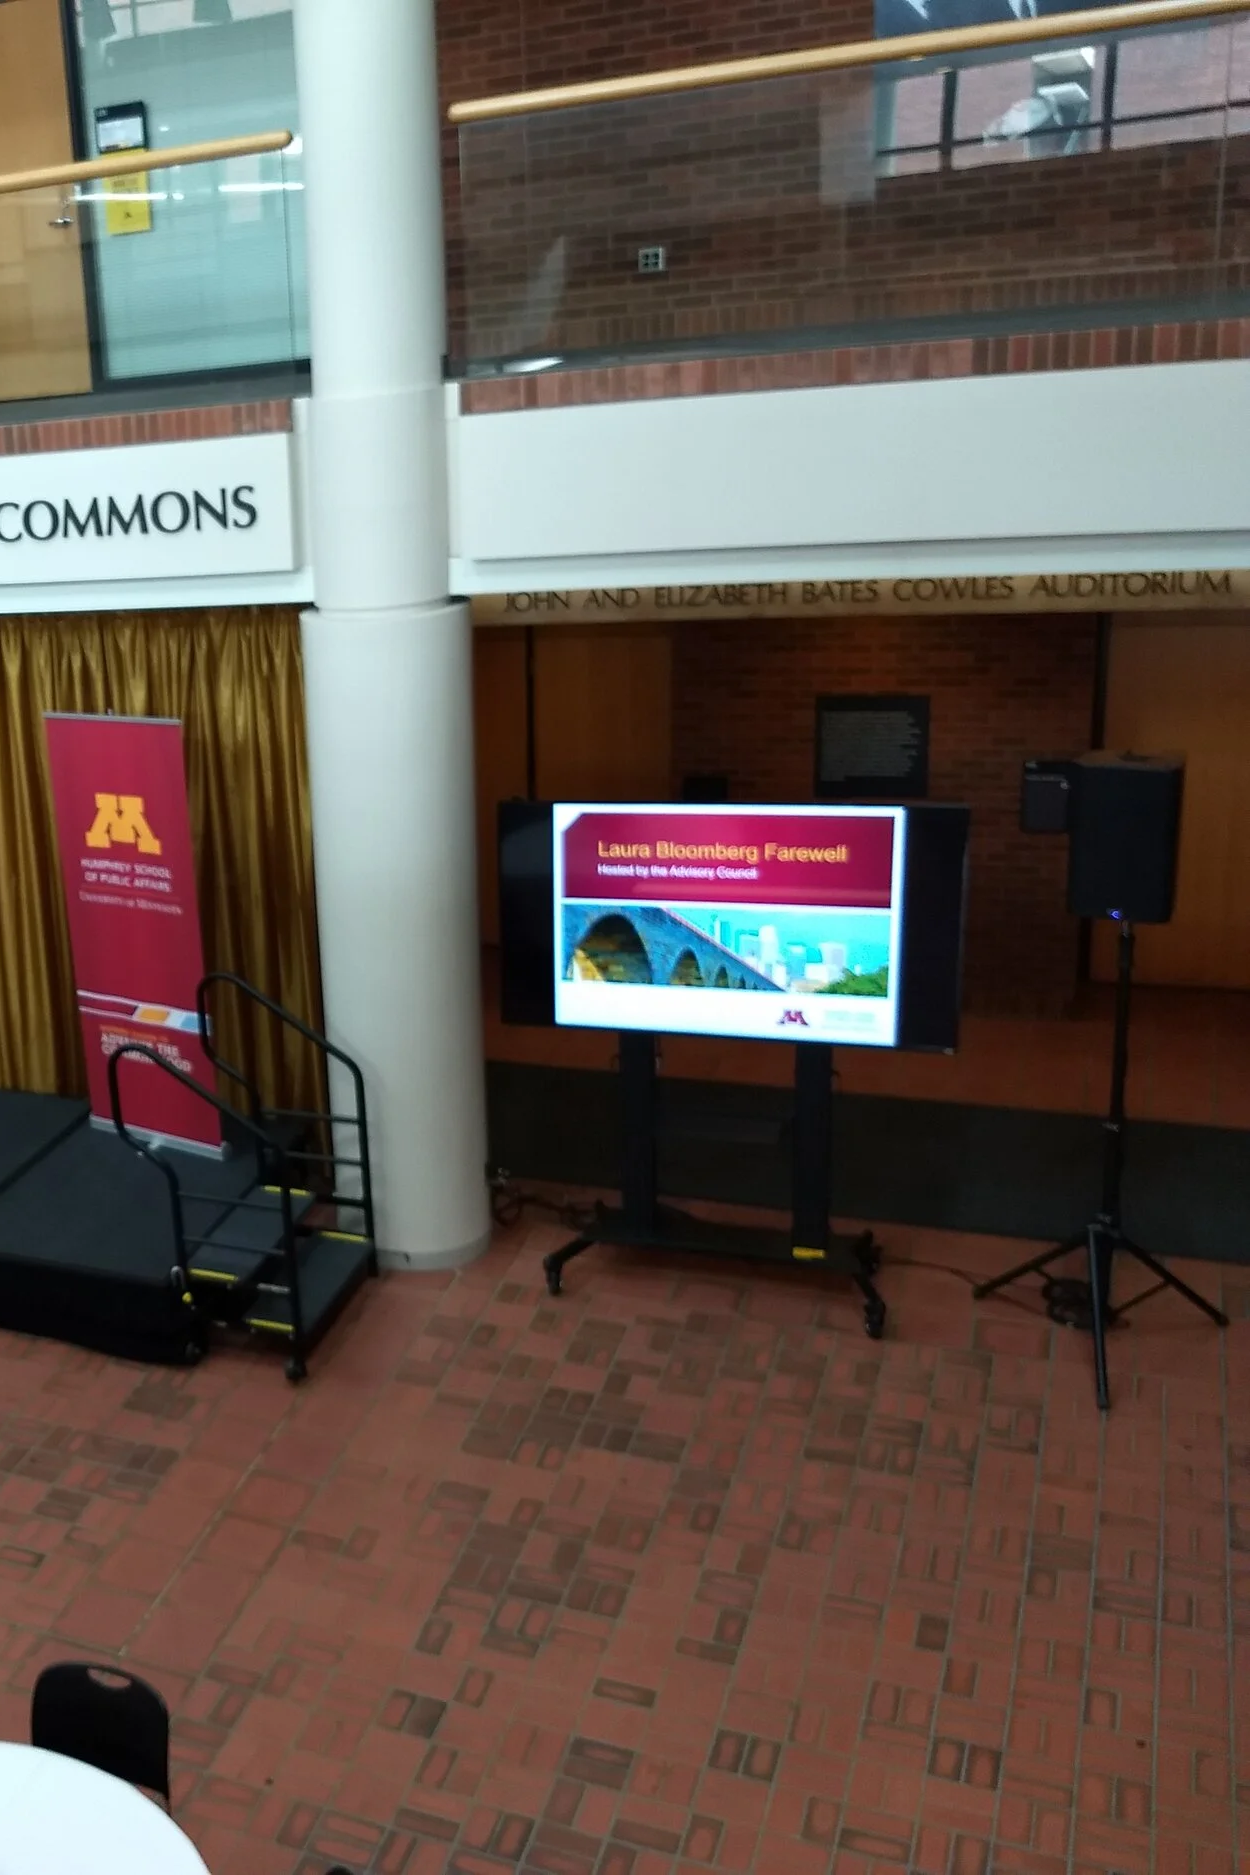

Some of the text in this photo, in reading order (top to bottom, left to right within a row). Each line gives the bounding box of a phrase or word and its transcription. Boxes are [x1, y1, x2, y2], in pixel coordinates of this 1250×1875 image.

[504, 570, 1232, 613] JOHN AND ELIZABETH BATES COWLES AUDITORIUM
[597, 840, 848, 865] Laura Bloomberg Farewell
